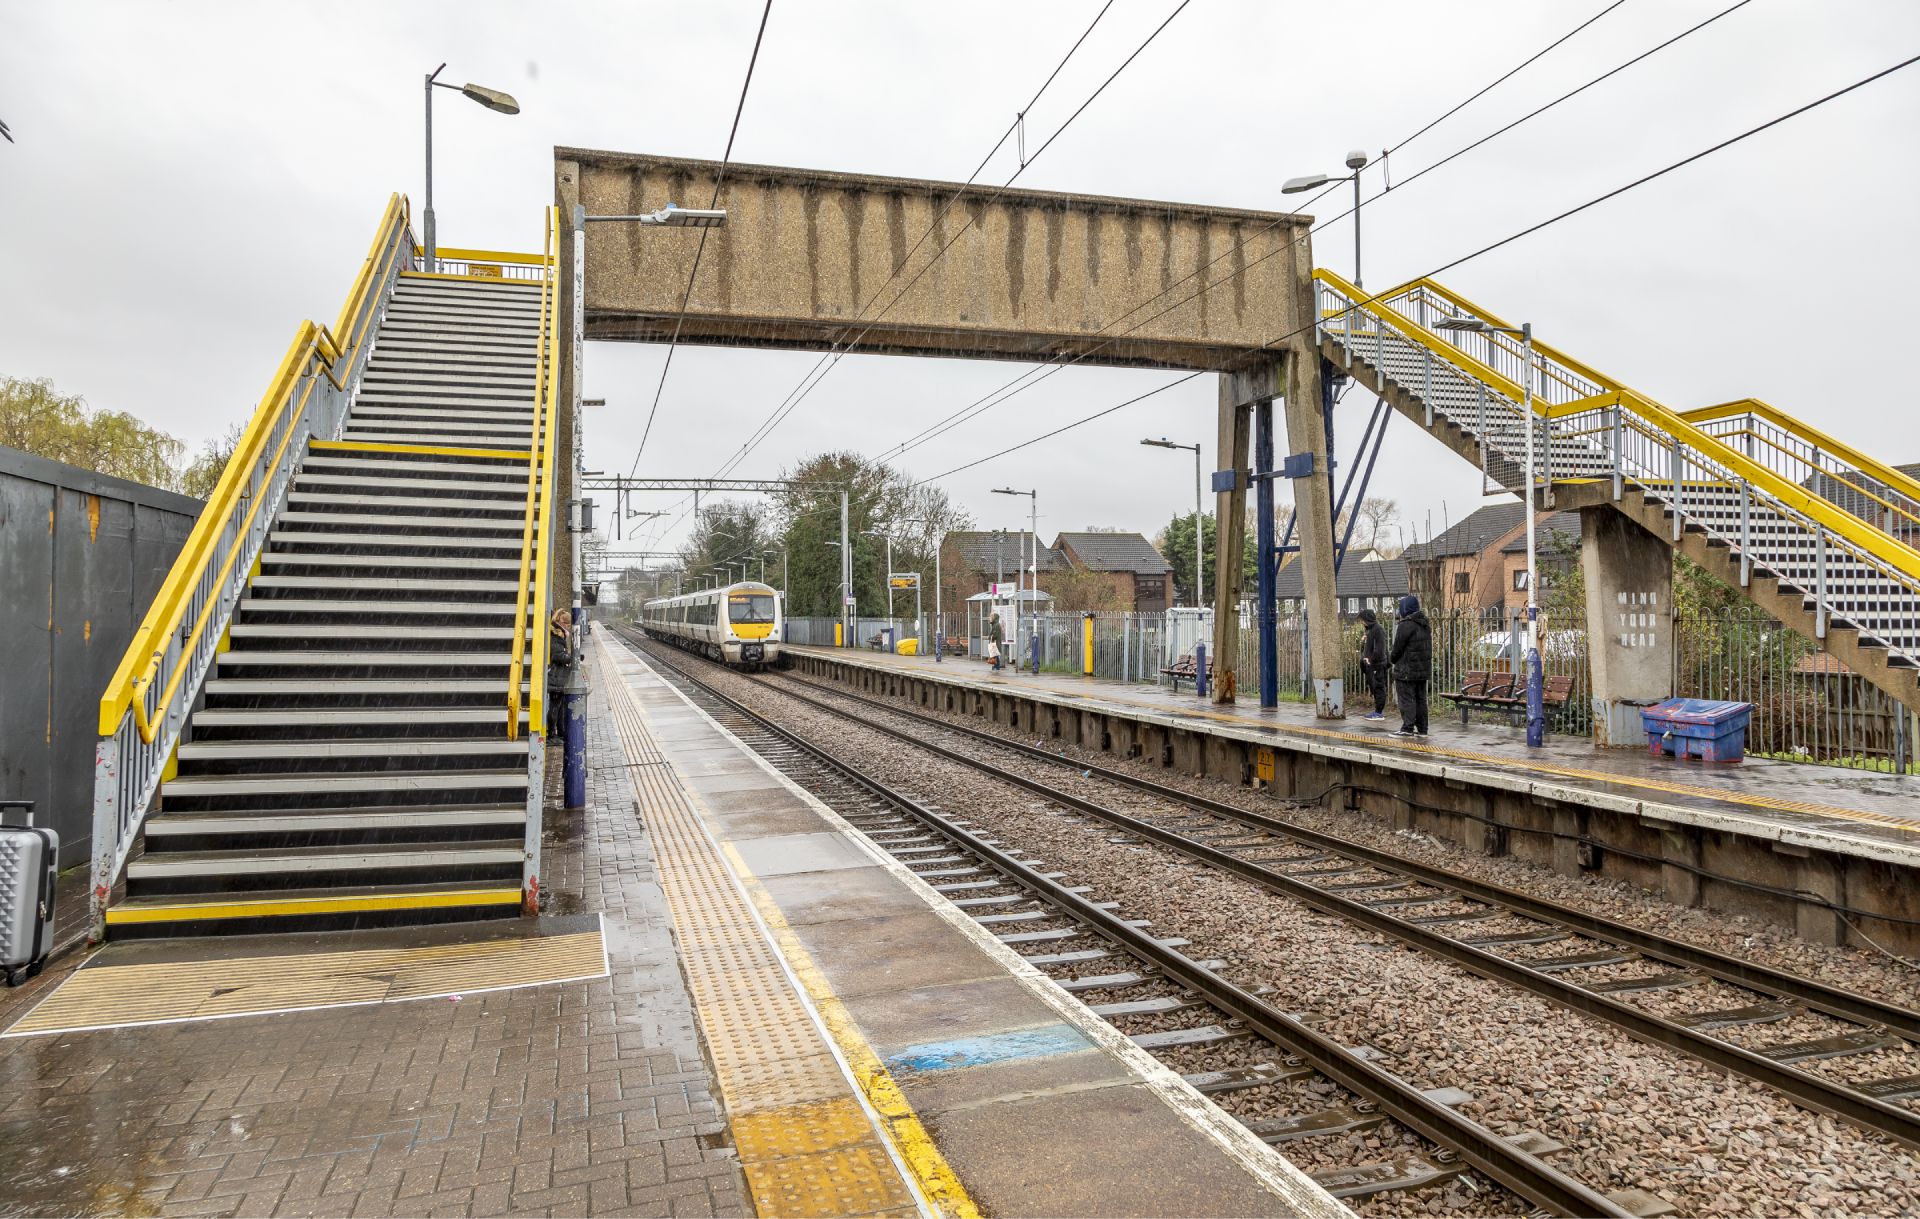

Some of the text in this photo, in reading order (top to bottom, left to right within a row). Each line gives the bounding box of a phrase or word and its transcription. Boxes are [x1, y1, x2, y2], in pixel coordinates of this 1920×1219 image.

[1617, 592, 1657, 605] MIND
[1619, 613, 1656, 627] YOUR
[1621, 633, 1656, 647] HEAD
